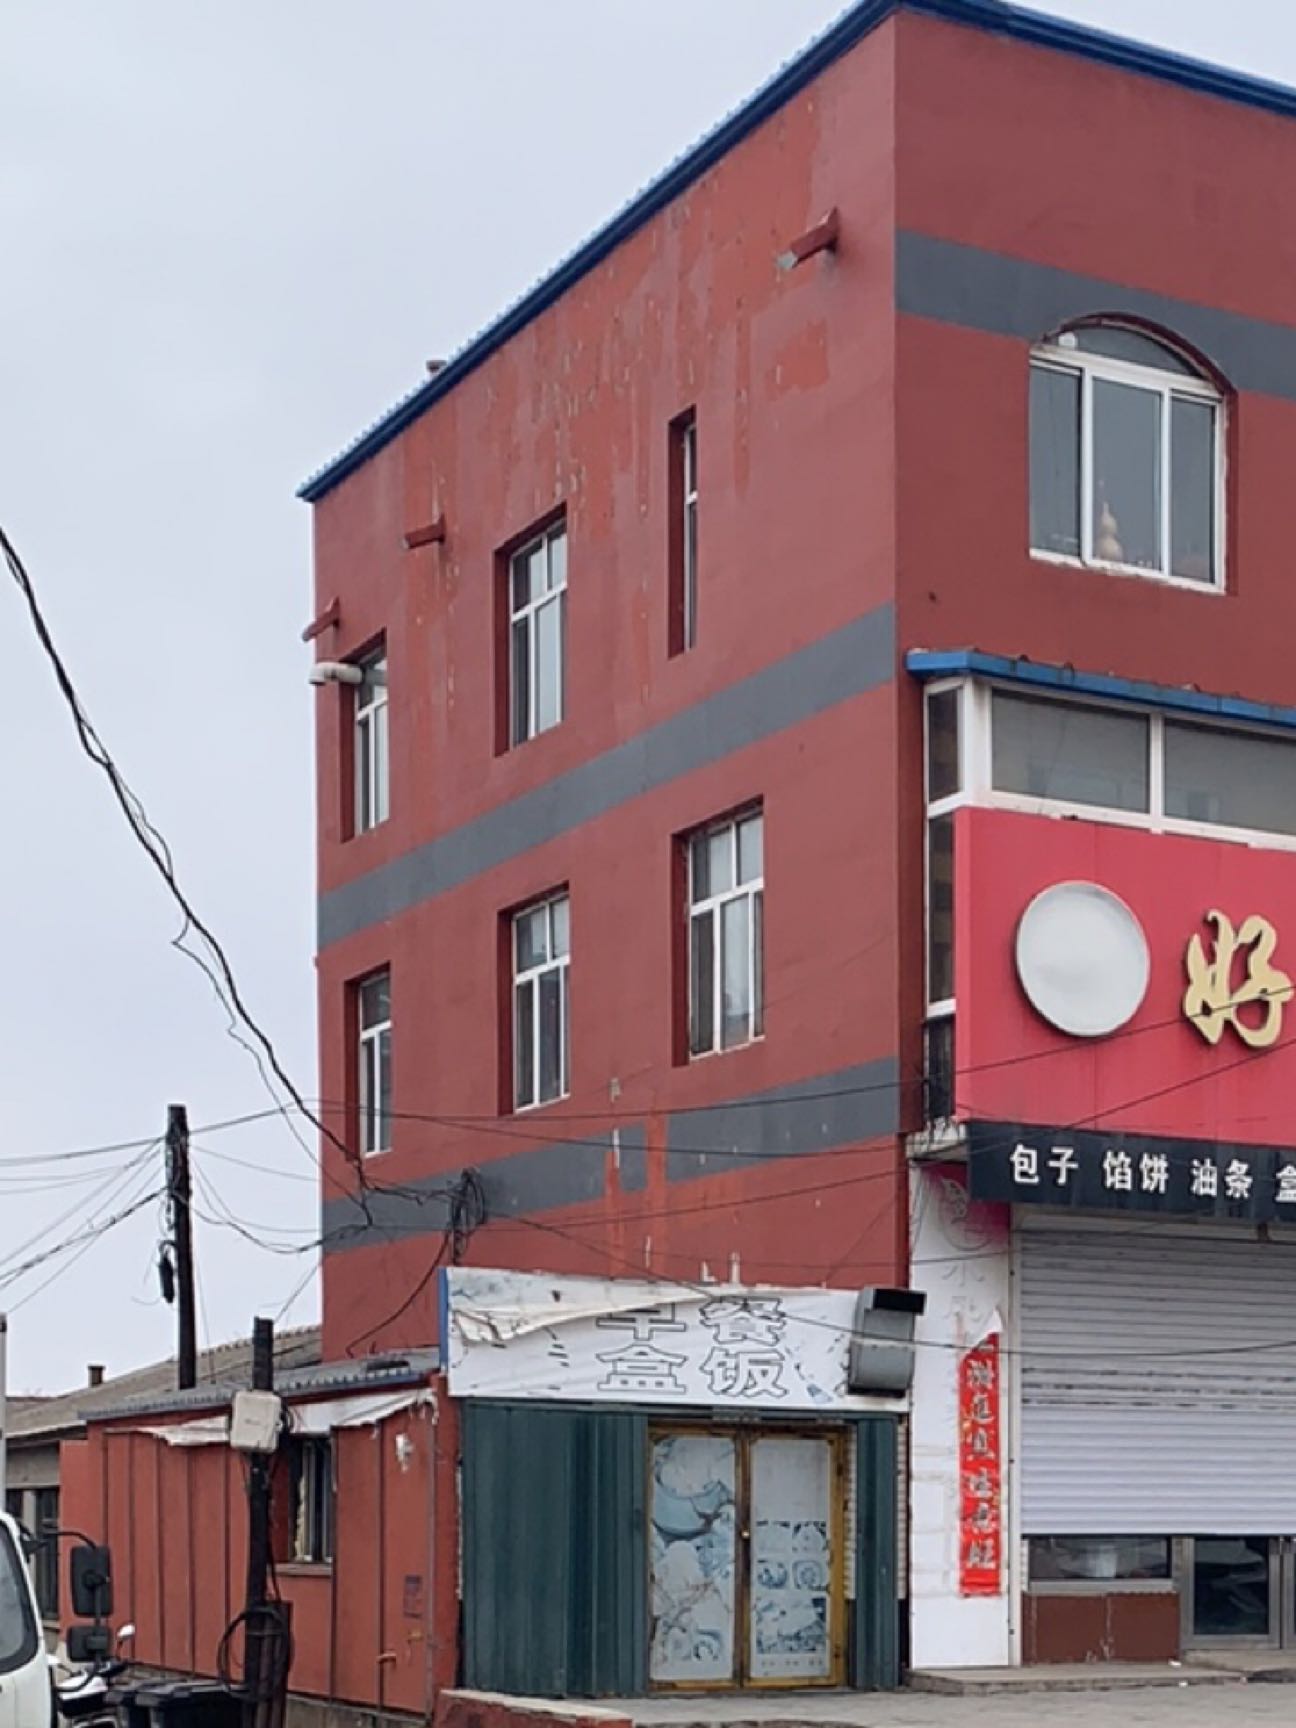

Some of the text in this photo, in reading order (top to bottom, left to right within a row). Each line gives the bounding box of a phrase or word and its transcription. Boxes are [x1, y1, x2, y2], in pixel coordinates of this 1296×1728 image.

[1010, 1144, 1079, 1185] 包子
[1103, 1151, 1169, 1194] 馅饼
[1190, 1158, 1253, 1199] 油条
[596, 1344, 788, 1397] 盒饭
